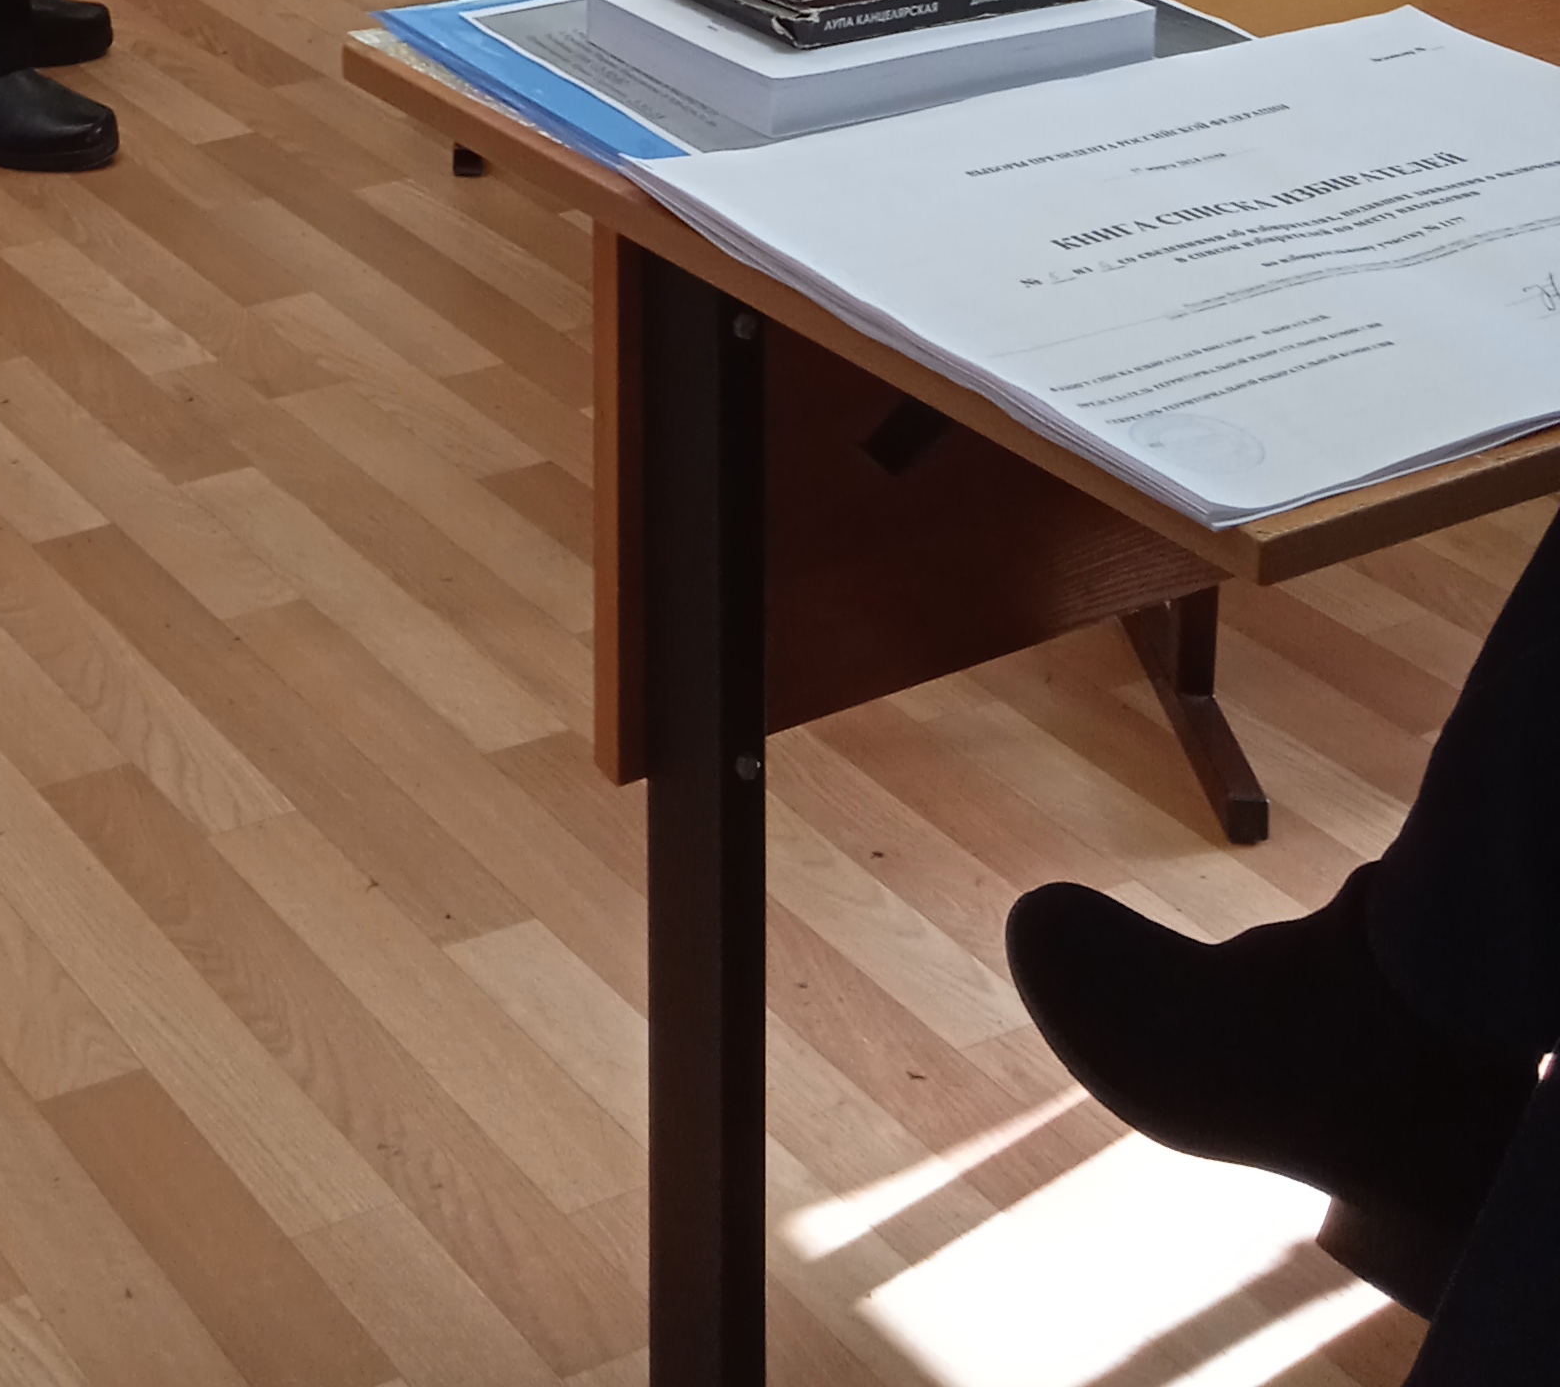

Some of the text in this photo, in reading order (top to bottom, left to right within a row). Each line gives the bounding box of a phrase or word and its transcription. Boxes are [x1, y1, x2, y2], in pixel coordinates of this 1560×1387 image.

[856, 1, 939, 26] КАНЦЕЛЯРСКАЯ
[965, 103, 1290, 177] ВЫБОРЫ ПРЕЗИДЕНТА РОССИЙСКОЙ ФЕДЕРАЦИИ
[1050, 151, 1468, 251] КНИГА СПИСКА ИЗБИРАТЕЛЕЙ
[1188, 243, 1241, 260] список
[1241, 229, 1333, 247] избирателей
[1353, 211, 1397, 227] месту
[1395, 190, 1481, 214] нахождения
[1137, 234, 1226, 260] сведениями
